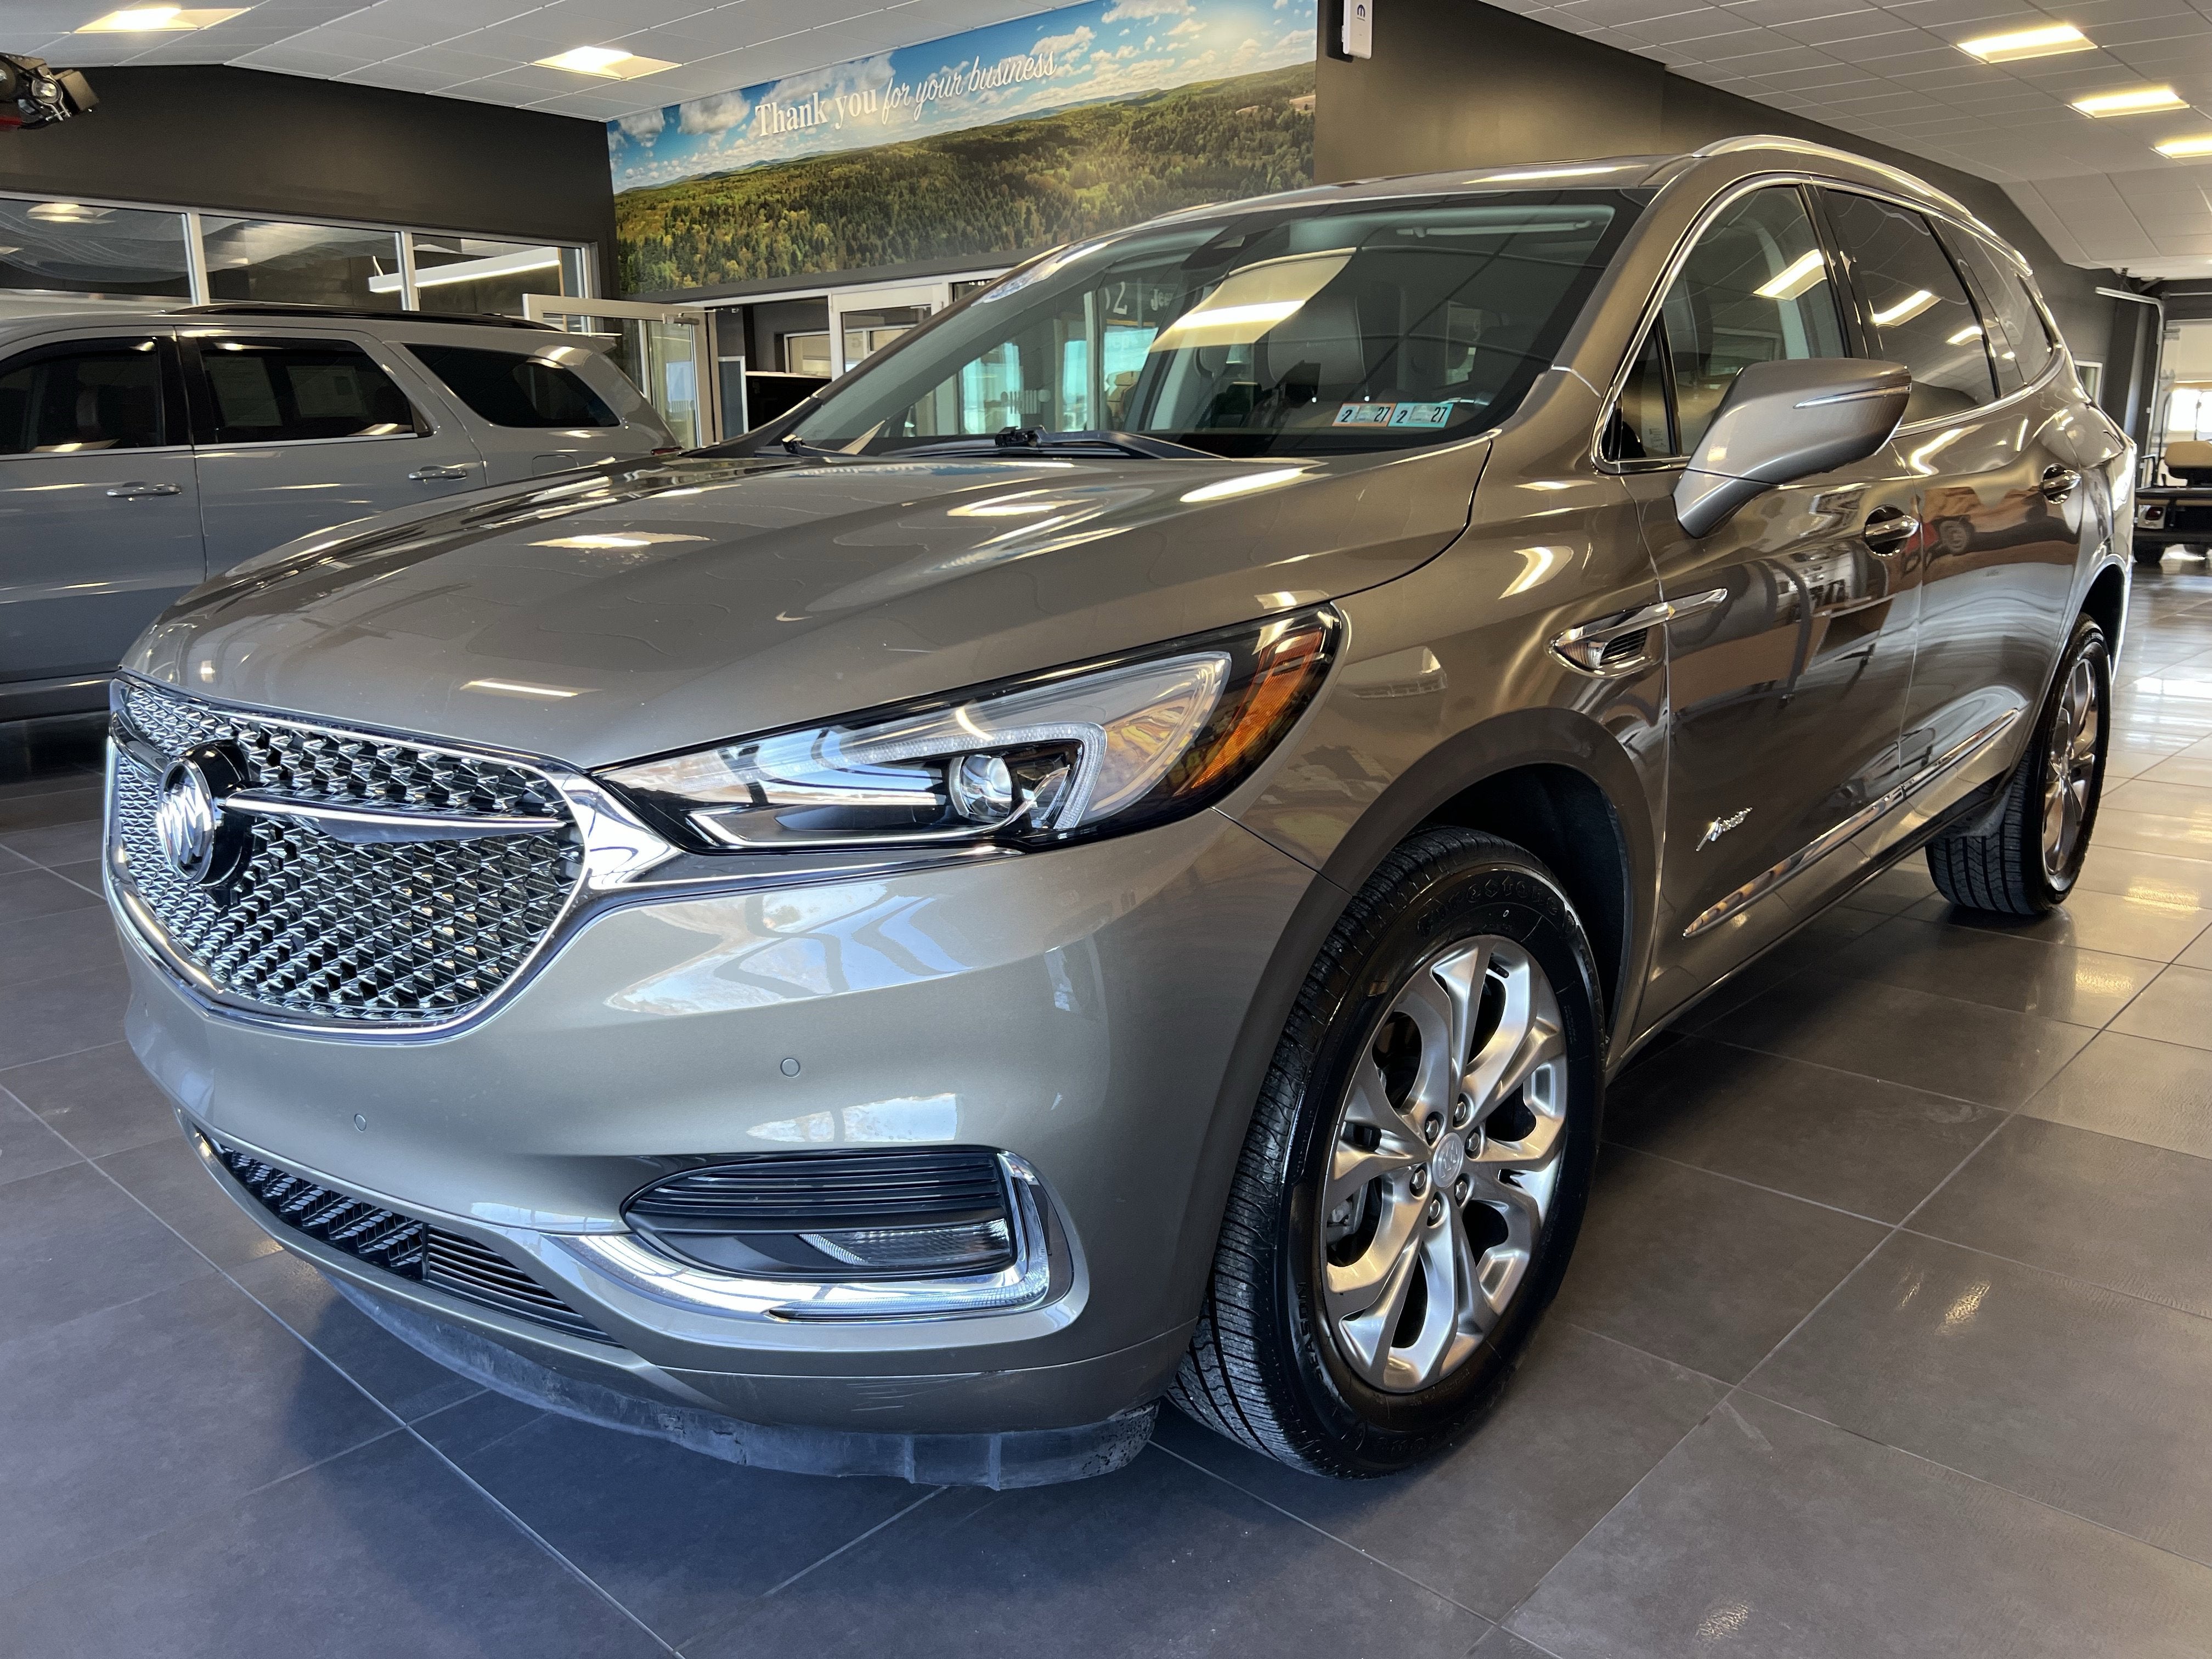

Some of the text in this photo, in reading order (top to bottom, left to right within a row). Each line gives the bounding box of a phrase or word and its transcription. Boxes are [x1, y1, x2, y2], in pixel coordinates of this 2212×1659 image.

[755, 50, 1057, 137] Thank you for your business
[1341, 409, 1353, 422] 2
[1374, 407, 1391, 422] 27
[1396, 410, 1408, 424] 2
[1430, 407, 1448, 423] 27
